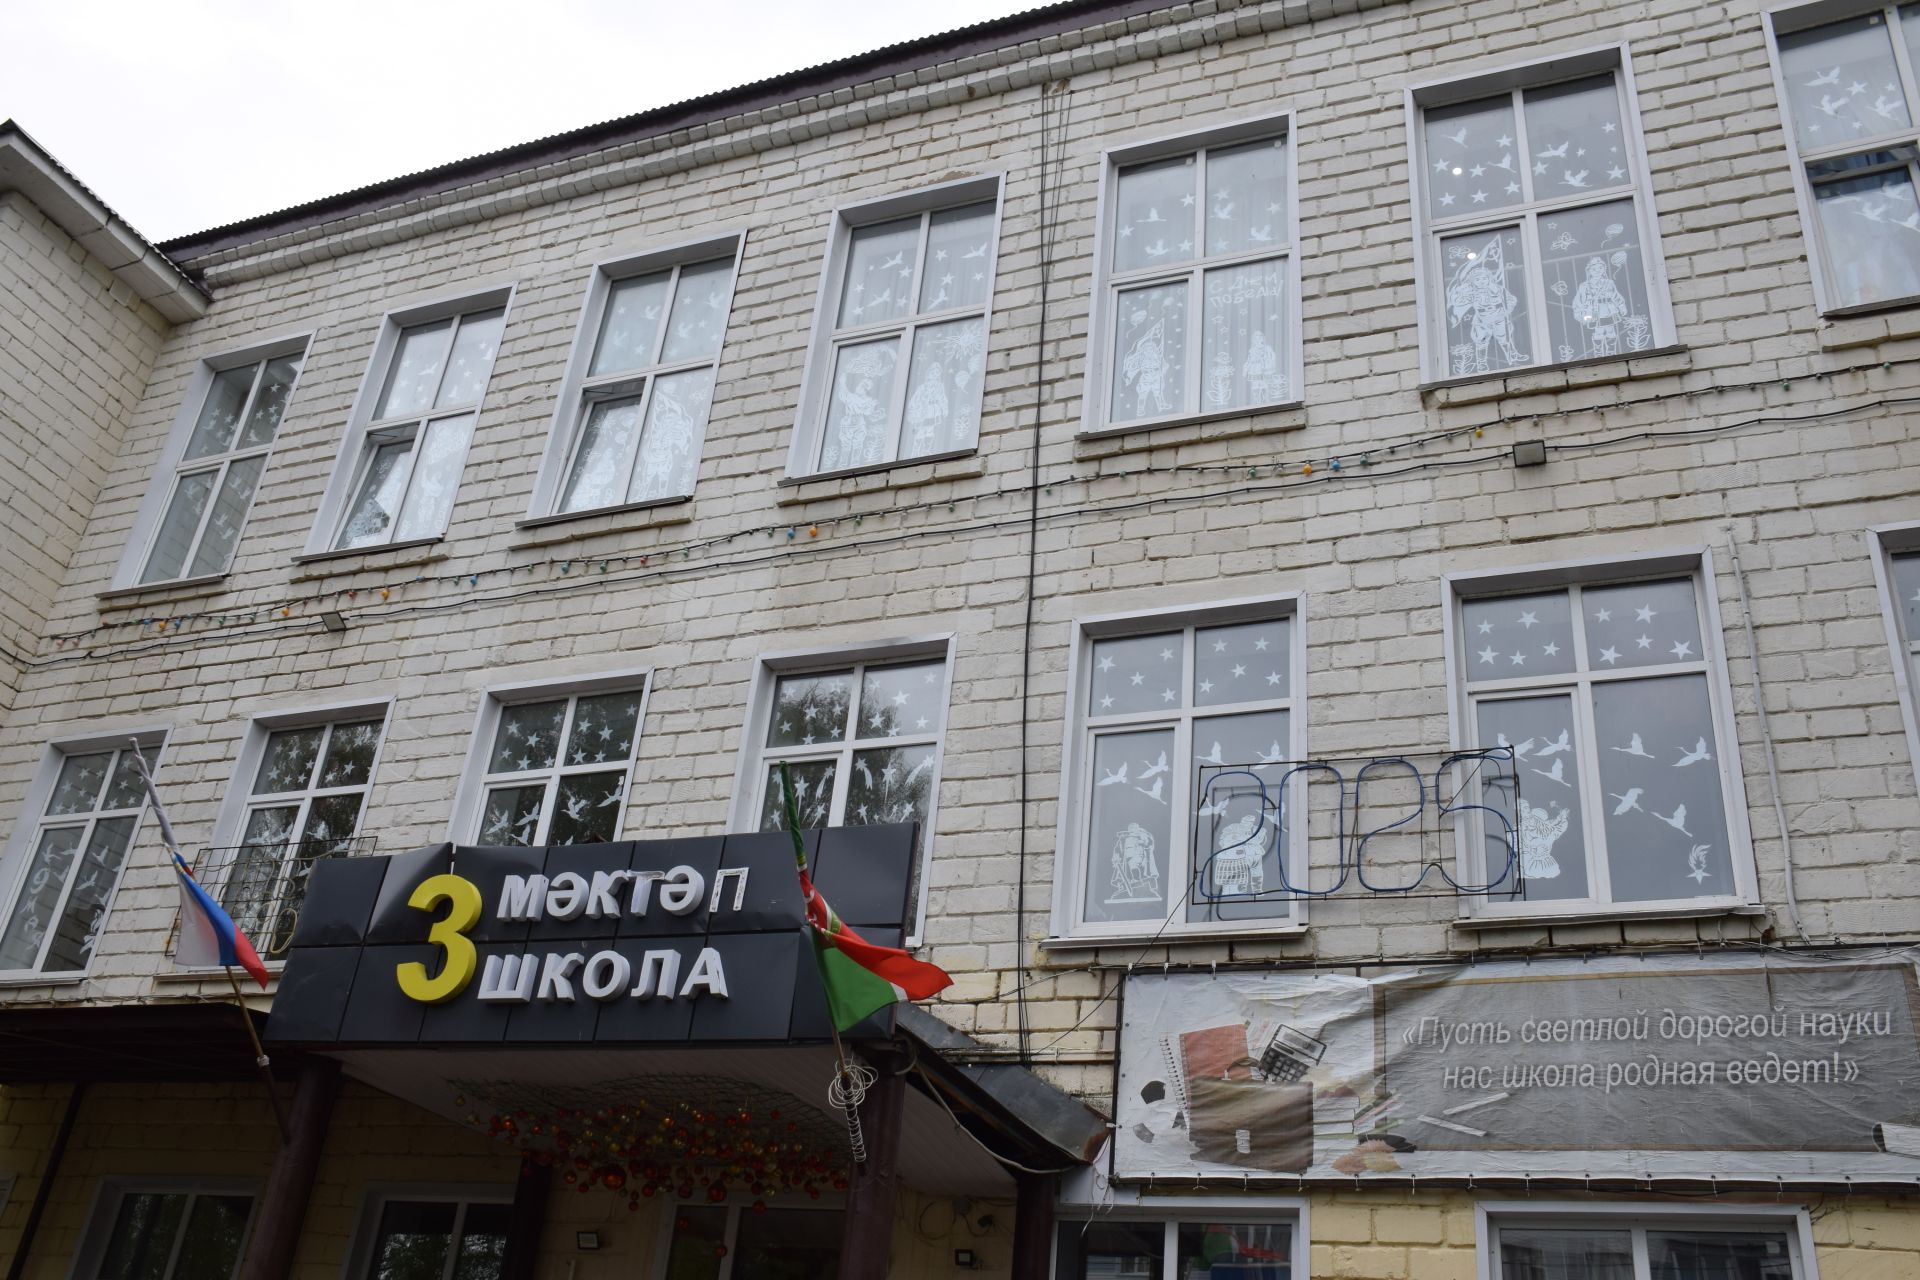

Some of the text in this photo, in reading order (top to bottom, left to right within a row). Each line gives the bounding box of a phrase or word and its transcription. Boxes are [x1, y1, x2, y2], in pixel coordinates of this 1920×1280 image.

[1200, 748, 1516, 897] 2025
[497, 865, 750, 922] МӘКТӘП
[396, 874, 482, 1003] 3
[477, 947, 729, 1003] ШКОЛА
[1402, 1005, 1891, 1053] «Пусть светлой дорогой науки
[1443, 1051, 1860, 1094] нас школа родная ведет!»
